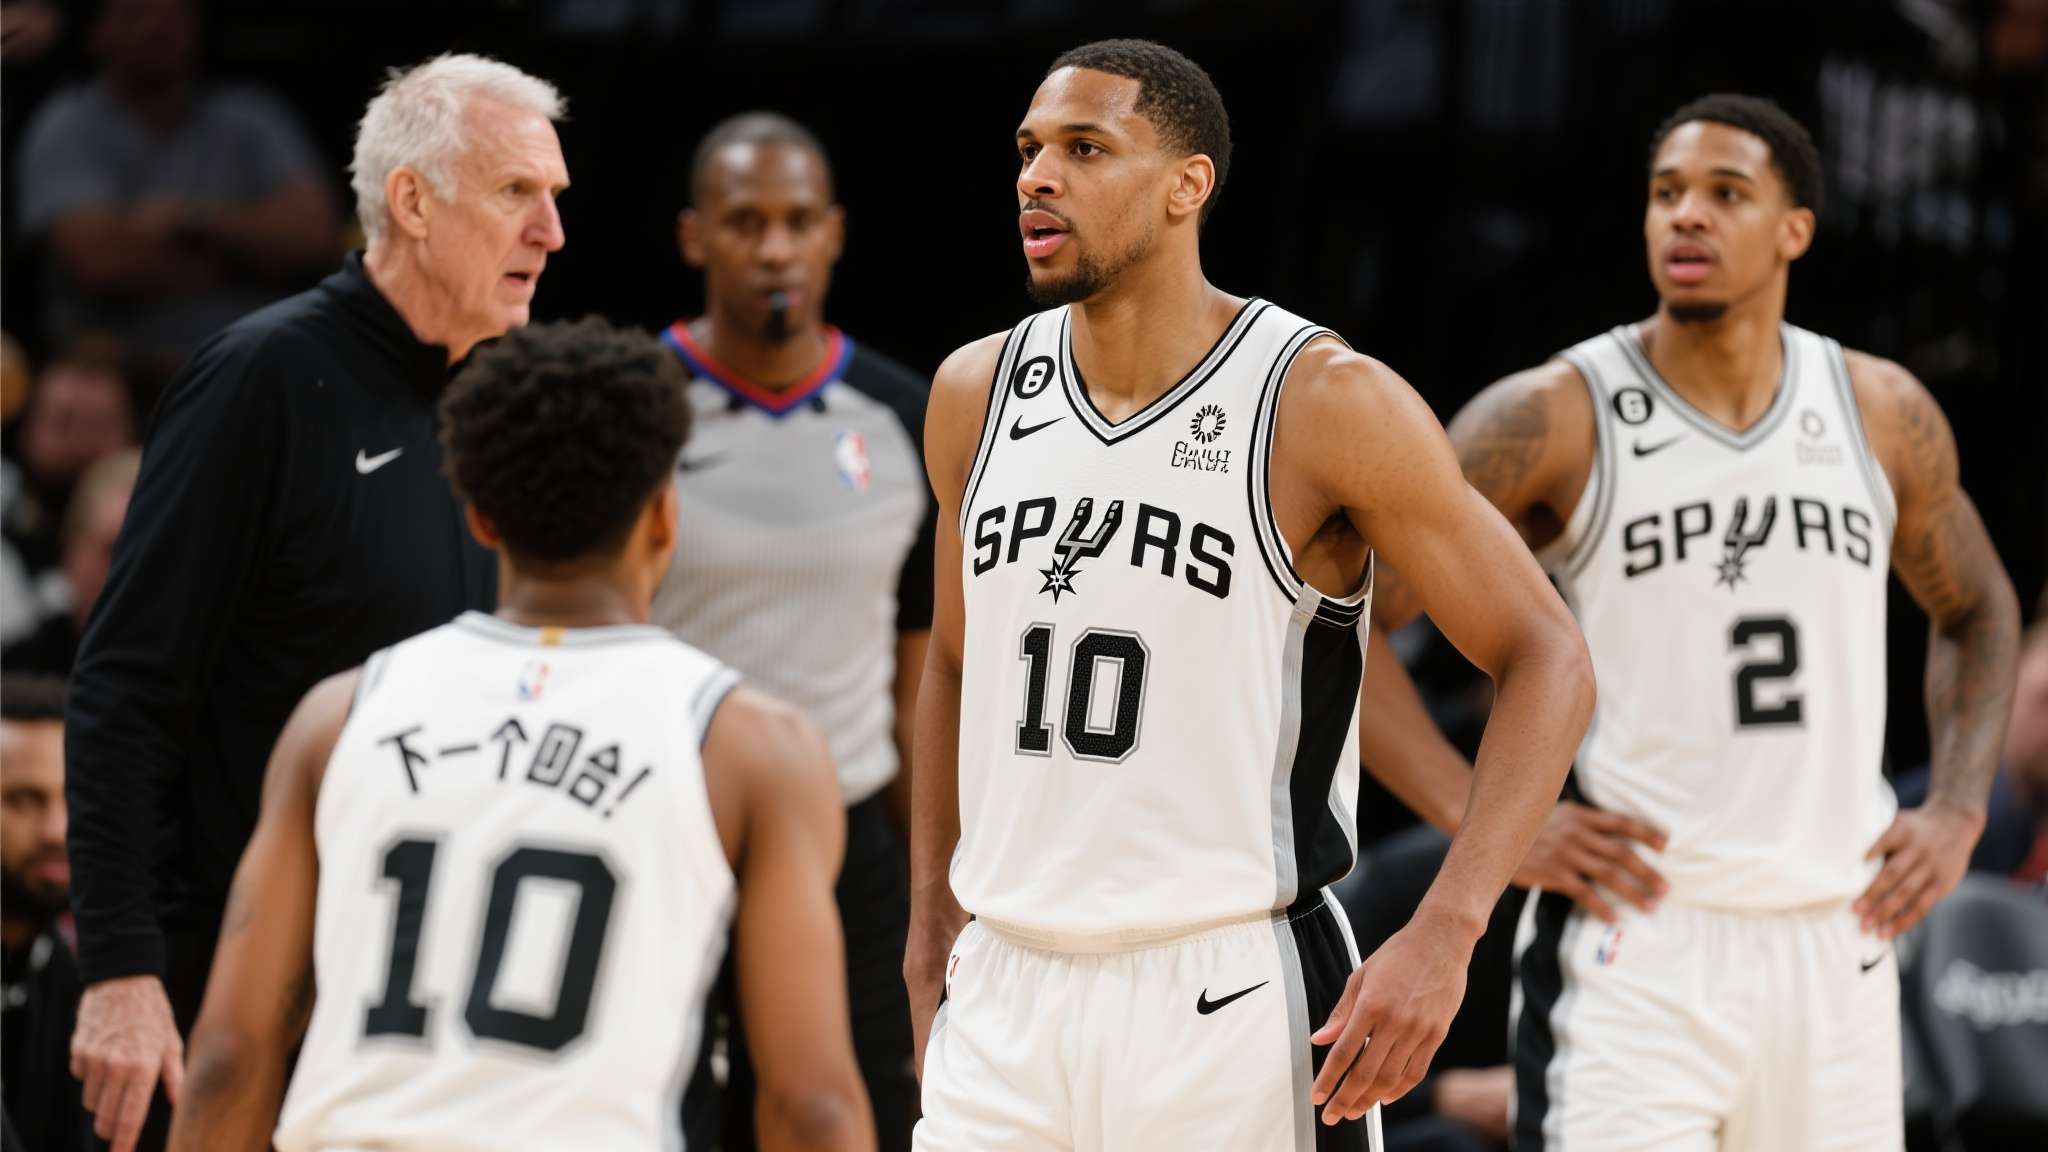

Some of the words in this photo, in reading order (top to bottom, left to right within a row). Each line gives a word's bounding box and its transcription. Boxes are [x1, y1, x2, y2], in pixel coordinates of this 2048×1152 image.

[973, 496, 1236, 604] SPURS
[1622, 497, 1872, 591] SPURS
[1015, 621, 1152, 765] 10
[1727, 613, 1807, 733] 2
[357, 832, 628, 1063] 10
